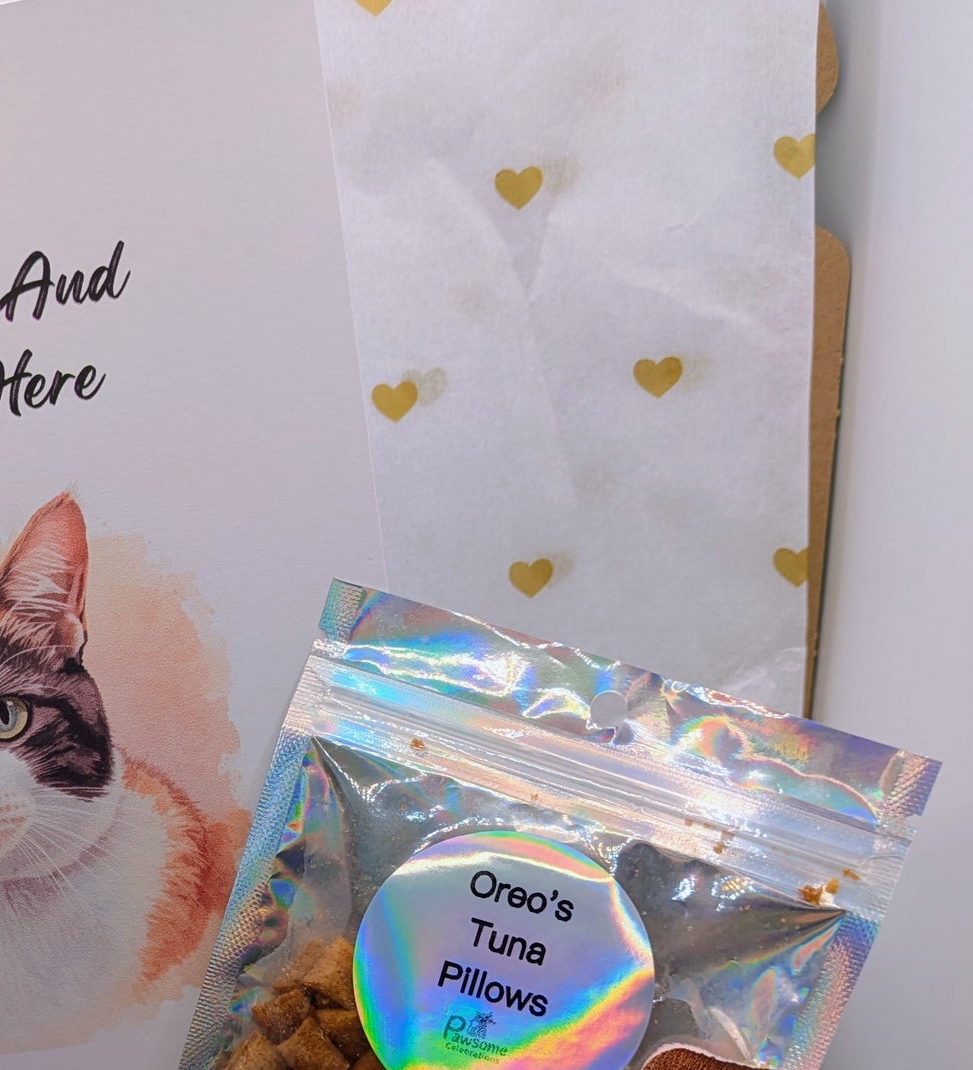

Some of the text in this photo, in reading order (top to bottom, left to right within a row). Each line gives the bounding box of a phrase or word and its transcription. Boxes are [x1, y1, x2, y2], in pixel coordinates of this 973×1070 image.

[469, 870, 574, 922] Oreo's
[470, 917, 547, 966] Tuna
[437, 960, 549, 1018] Pillows
[443, 1014, 508, 1056] Pawsome
